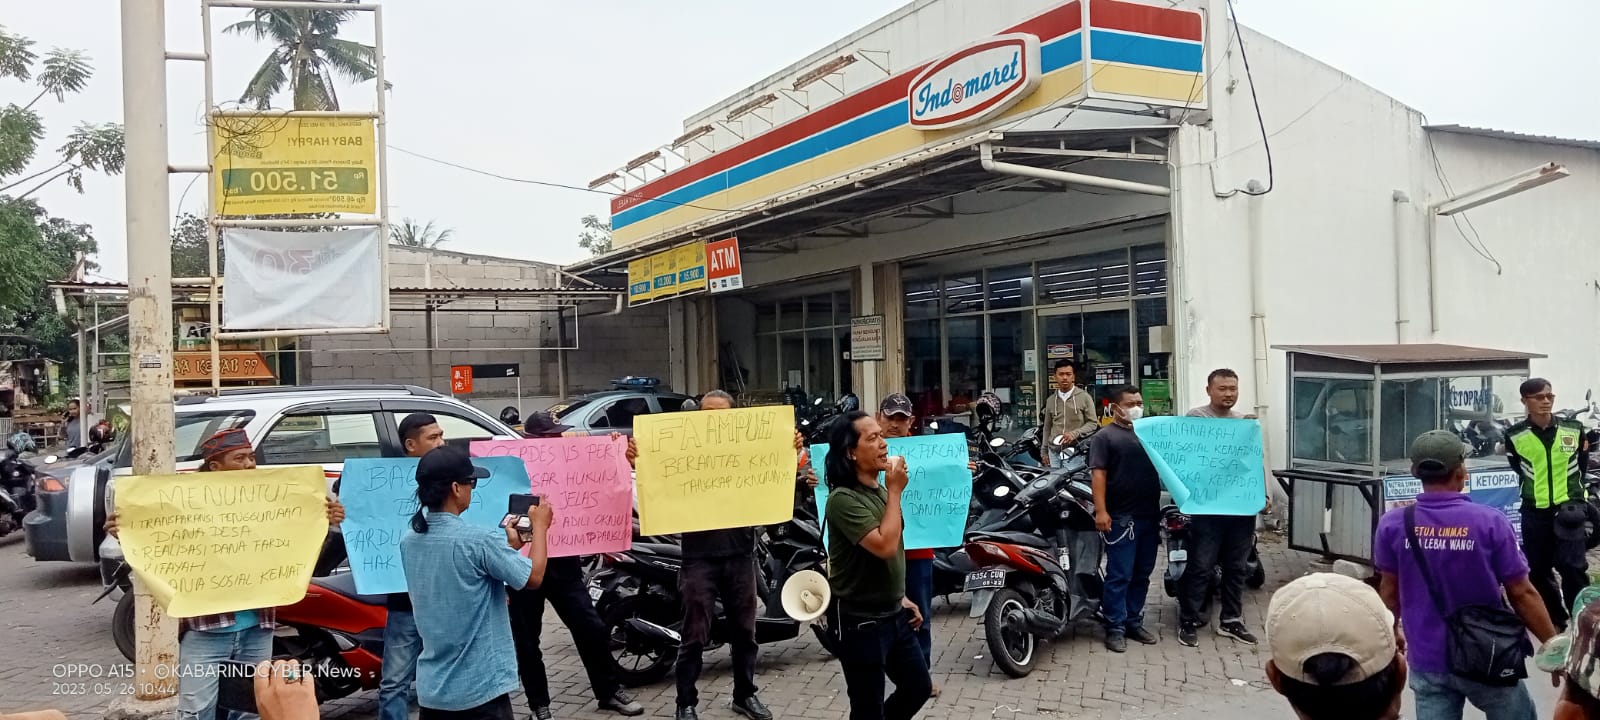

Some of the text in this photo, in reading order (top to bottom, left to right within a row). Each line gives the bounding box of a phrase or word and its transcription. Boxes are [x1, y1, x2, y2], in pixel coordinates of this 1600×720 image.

[710, 246, 736, 273] ATM
[196, 358, 239, 375] KEAB
[243, 359, 258, 375] 99
[706, 411, 777, 445] AMPUH
[1150, 421, 1236, 440] KEMANAKAH
[561, 444, 580, 464] VS
[1175, 441, 1210, 453] SOSIAL
[659, 452, 781, 478] BERANTAS KKN
[1198, 455, 1239, 471] DESA
[566, 466, 618, 487] HUKUM
[158, 482, 300, 511] MENUNTUT
[557, 490, 601, 510] JELAS
[908, 502, 943, 516] DANA
[562, 515, 590, 528] ADILI
[150, 524, 251, 543] DANA DESA
[1411, 526, 1469, 538] ETUA LINMAS
[142, 543, 207, 561] REALISASI
[211, 540, 248, 555] DANA
[1424, 538, 1447, 550] LEBAK
[1450, 538, 1475, 551] WANGI
[363, 554, 397, 573] HAK
[209, 573, 253, 590] SOSIAL
